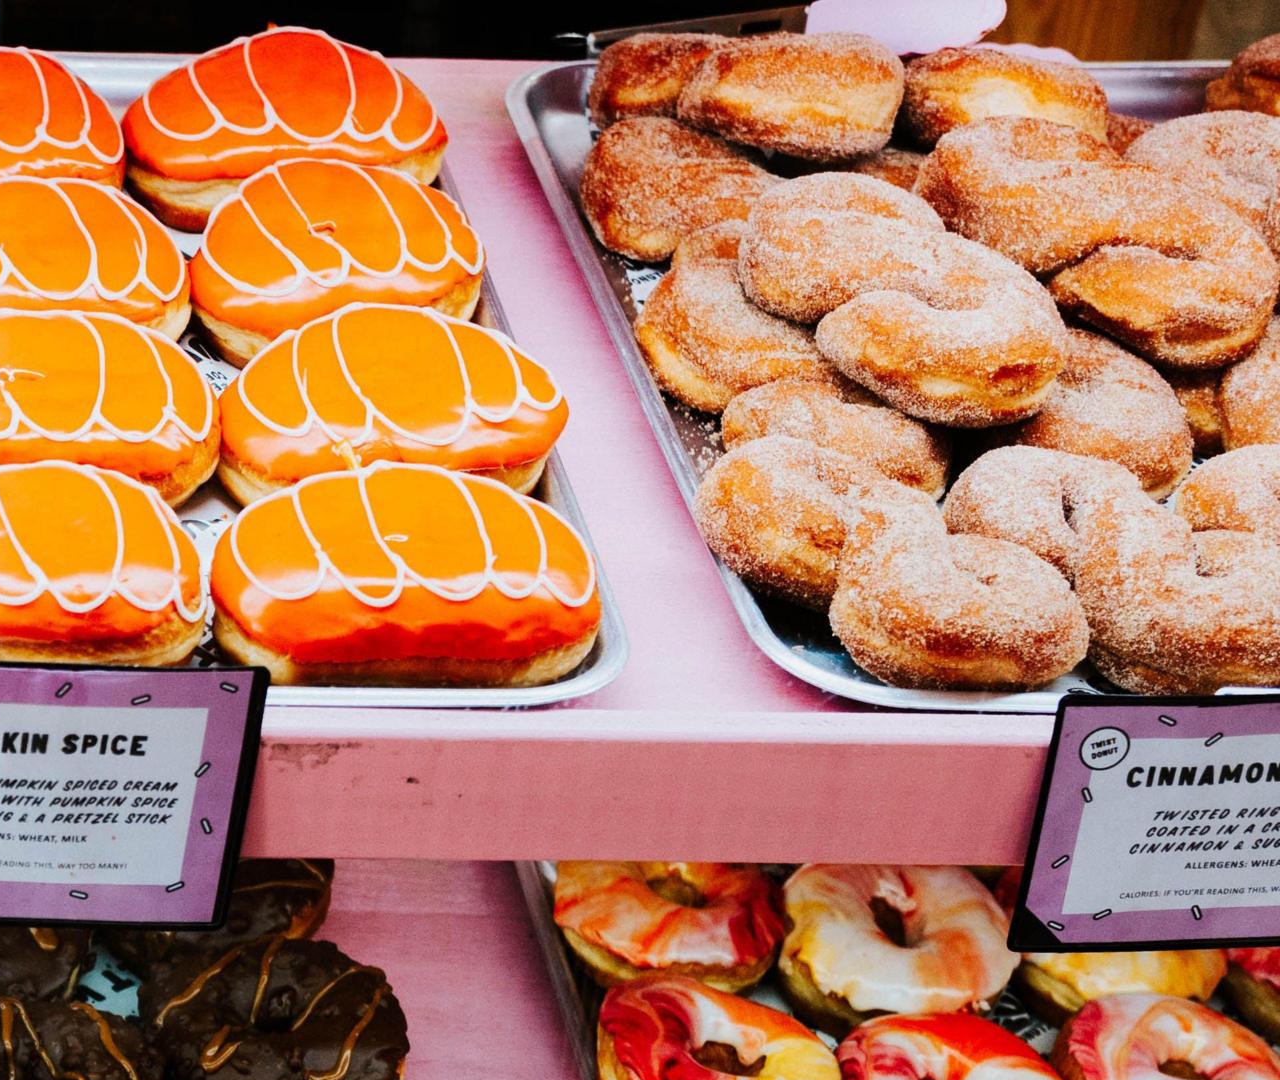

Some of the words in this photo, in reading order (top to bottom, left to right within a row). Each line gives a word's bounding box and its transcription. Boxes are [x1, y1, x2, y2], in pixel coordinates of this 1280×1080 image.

[61, 734, 148, 757] SPICE
[1091, 737, 1117, 750] TWIST
[1091, 747, 1119, 760] DONUT
[62, 779, 119, 792] SPICED
[123, 780, 179, 792] CREAM
[1, 794, 45, 807] WITH
[49, 796, 127, 808] PUMPKIN
[131, 796, 179, 809] SPICE
[18, 813, 29, 823] &
[34, 813, 47, 823] A
[51, 812, 119, 825] PRETZEL
[124, 812, 172, 825] STICK
[1153, 808, 1231, 821] TWISTED
[1145, 825, 1211, 838] COATED
[1216, 824, 1240, 835] IN
[1243, 823, 1256, 834] A
[1129, 840, 1229, 855] CINNAMON
[1233, 840, 1245, 851] &
